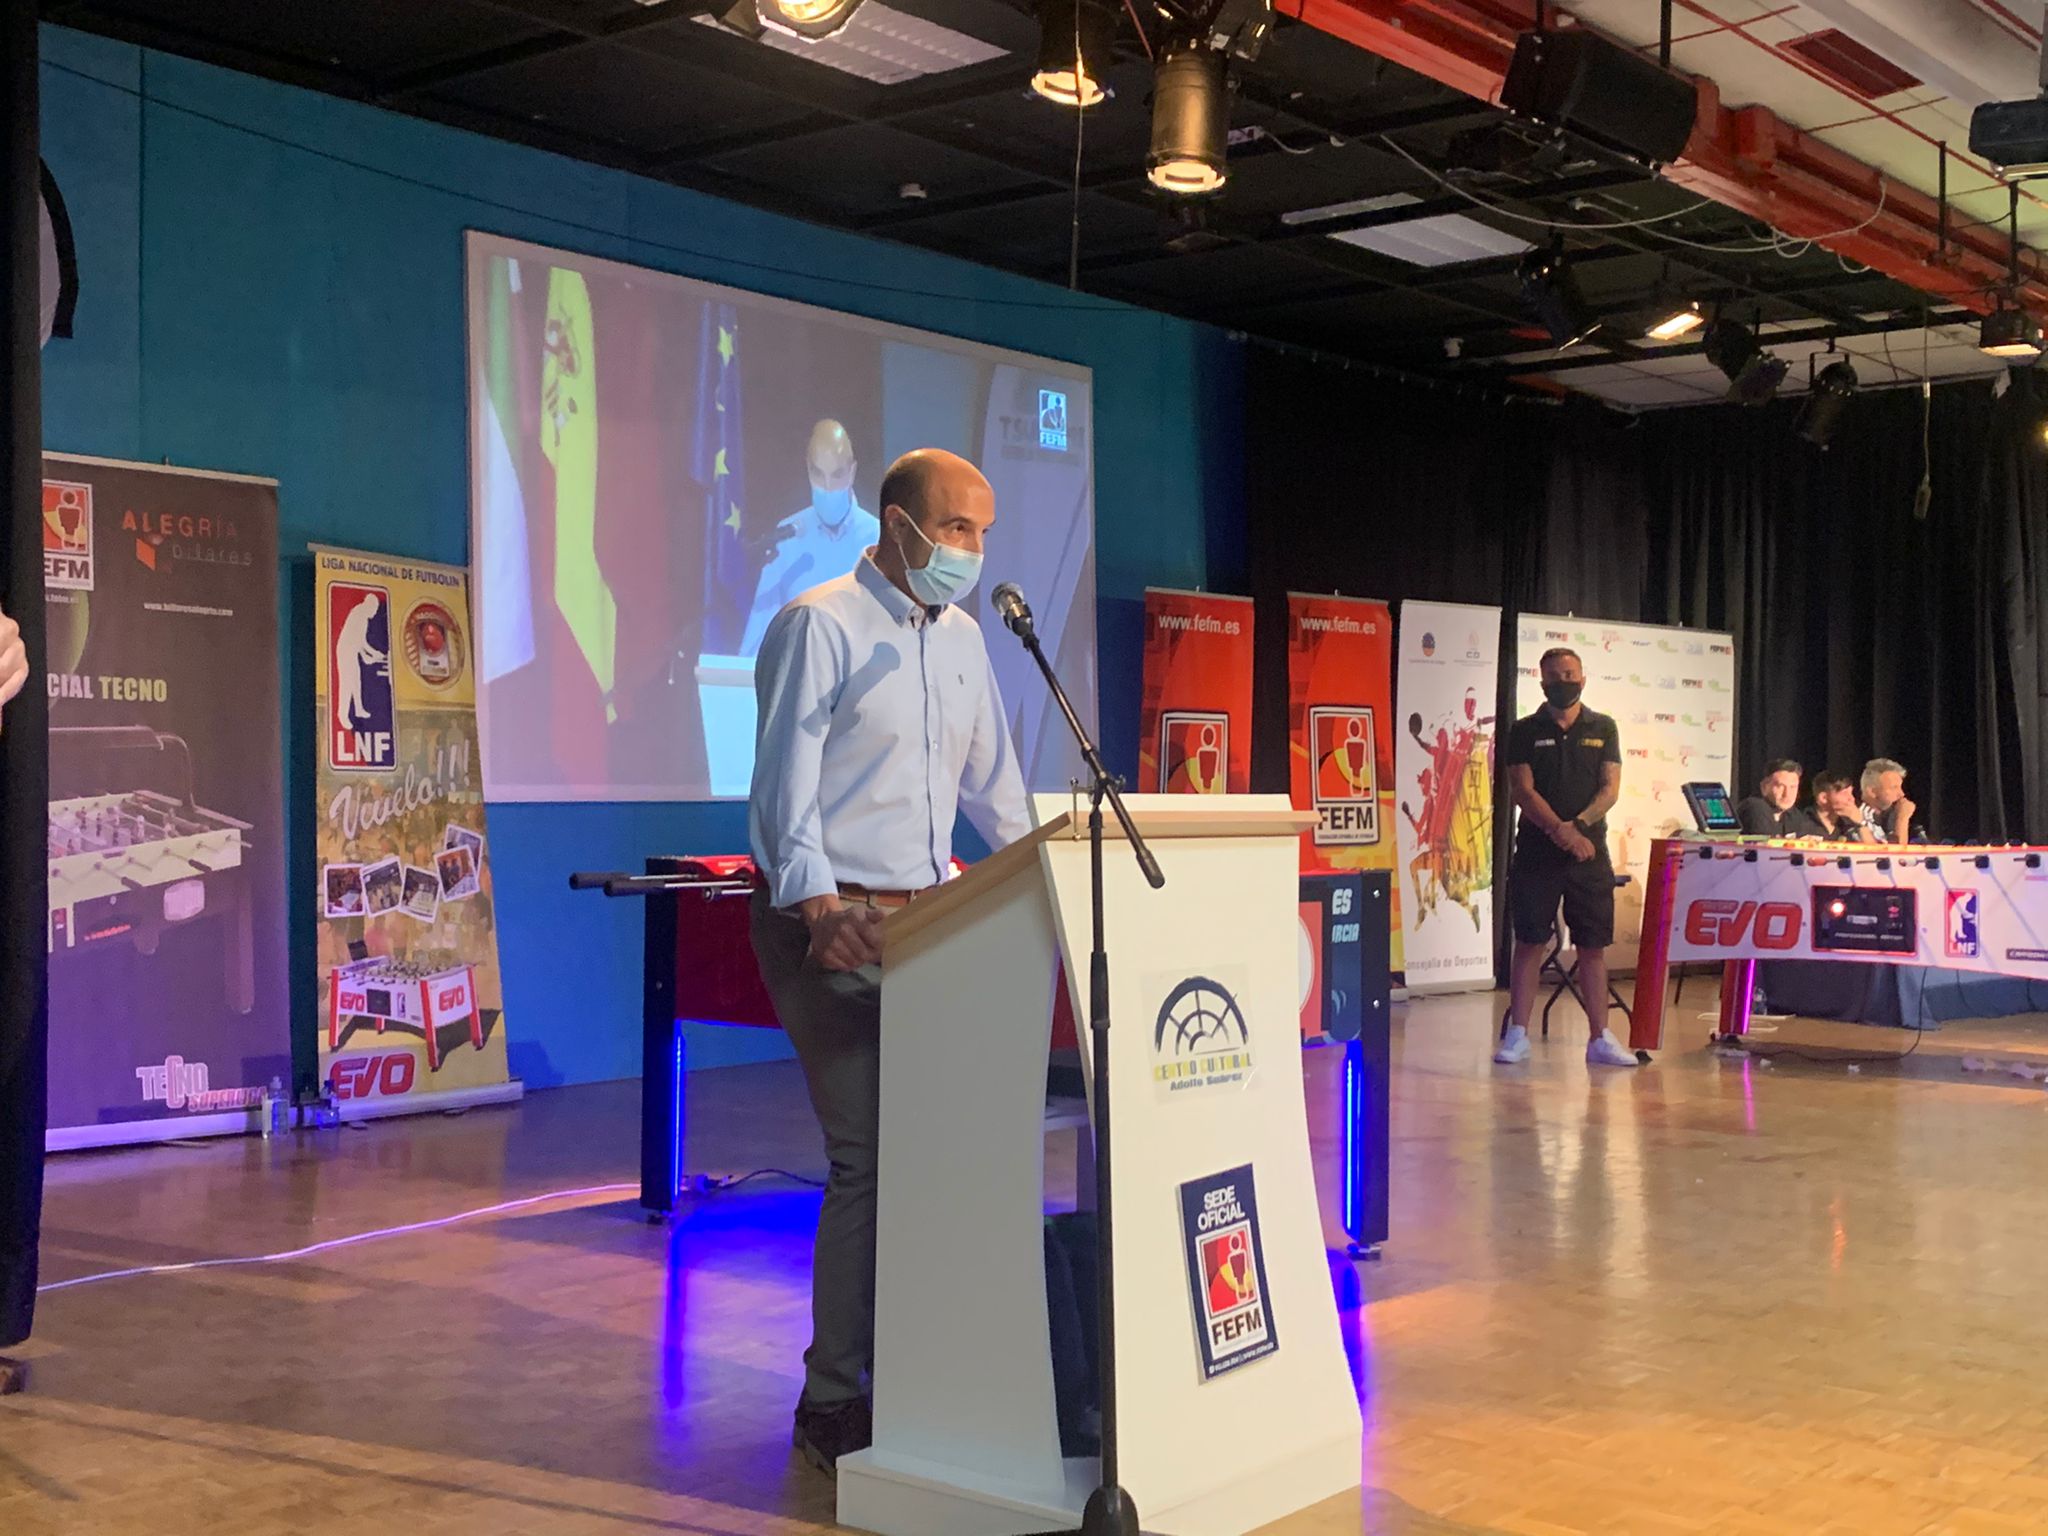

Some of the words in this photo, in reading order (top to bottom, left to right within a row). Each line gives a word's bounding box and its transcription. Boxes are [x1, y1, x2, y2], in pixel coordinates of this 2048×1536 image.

[321, 558, 345, 570] LIGA
[348, 561, 399, 578] NACIONAL
[401, 567, 414, 581] DE
[1159, 614, 1240, 636] www.fefm.es
[1300, 615, 1376, 635] www.fefm.es
[98, 676, 167, 702] TECNO
[337, 731, 391, 762] LNF
[1317, 806, 1373, 830] FEFM
[1684, 899, 1803, 950] EVO
[1950, 942, 1976, 955] LNF
[340, 992, 365, 1012] EVO
[439, 985, 465, 1011] EVO
[136, 1055, 209, 1108] TECNO
[330, 1053, 415, 1100] EVO
[1170, 1078, 1203, 1091] Adolfo
[1204, 1185, 1236, 1210] SEDE
[1197, 1201, 1246, 1231] OFICIAL
[1211, 1307, 1262, 1346] FEFM
